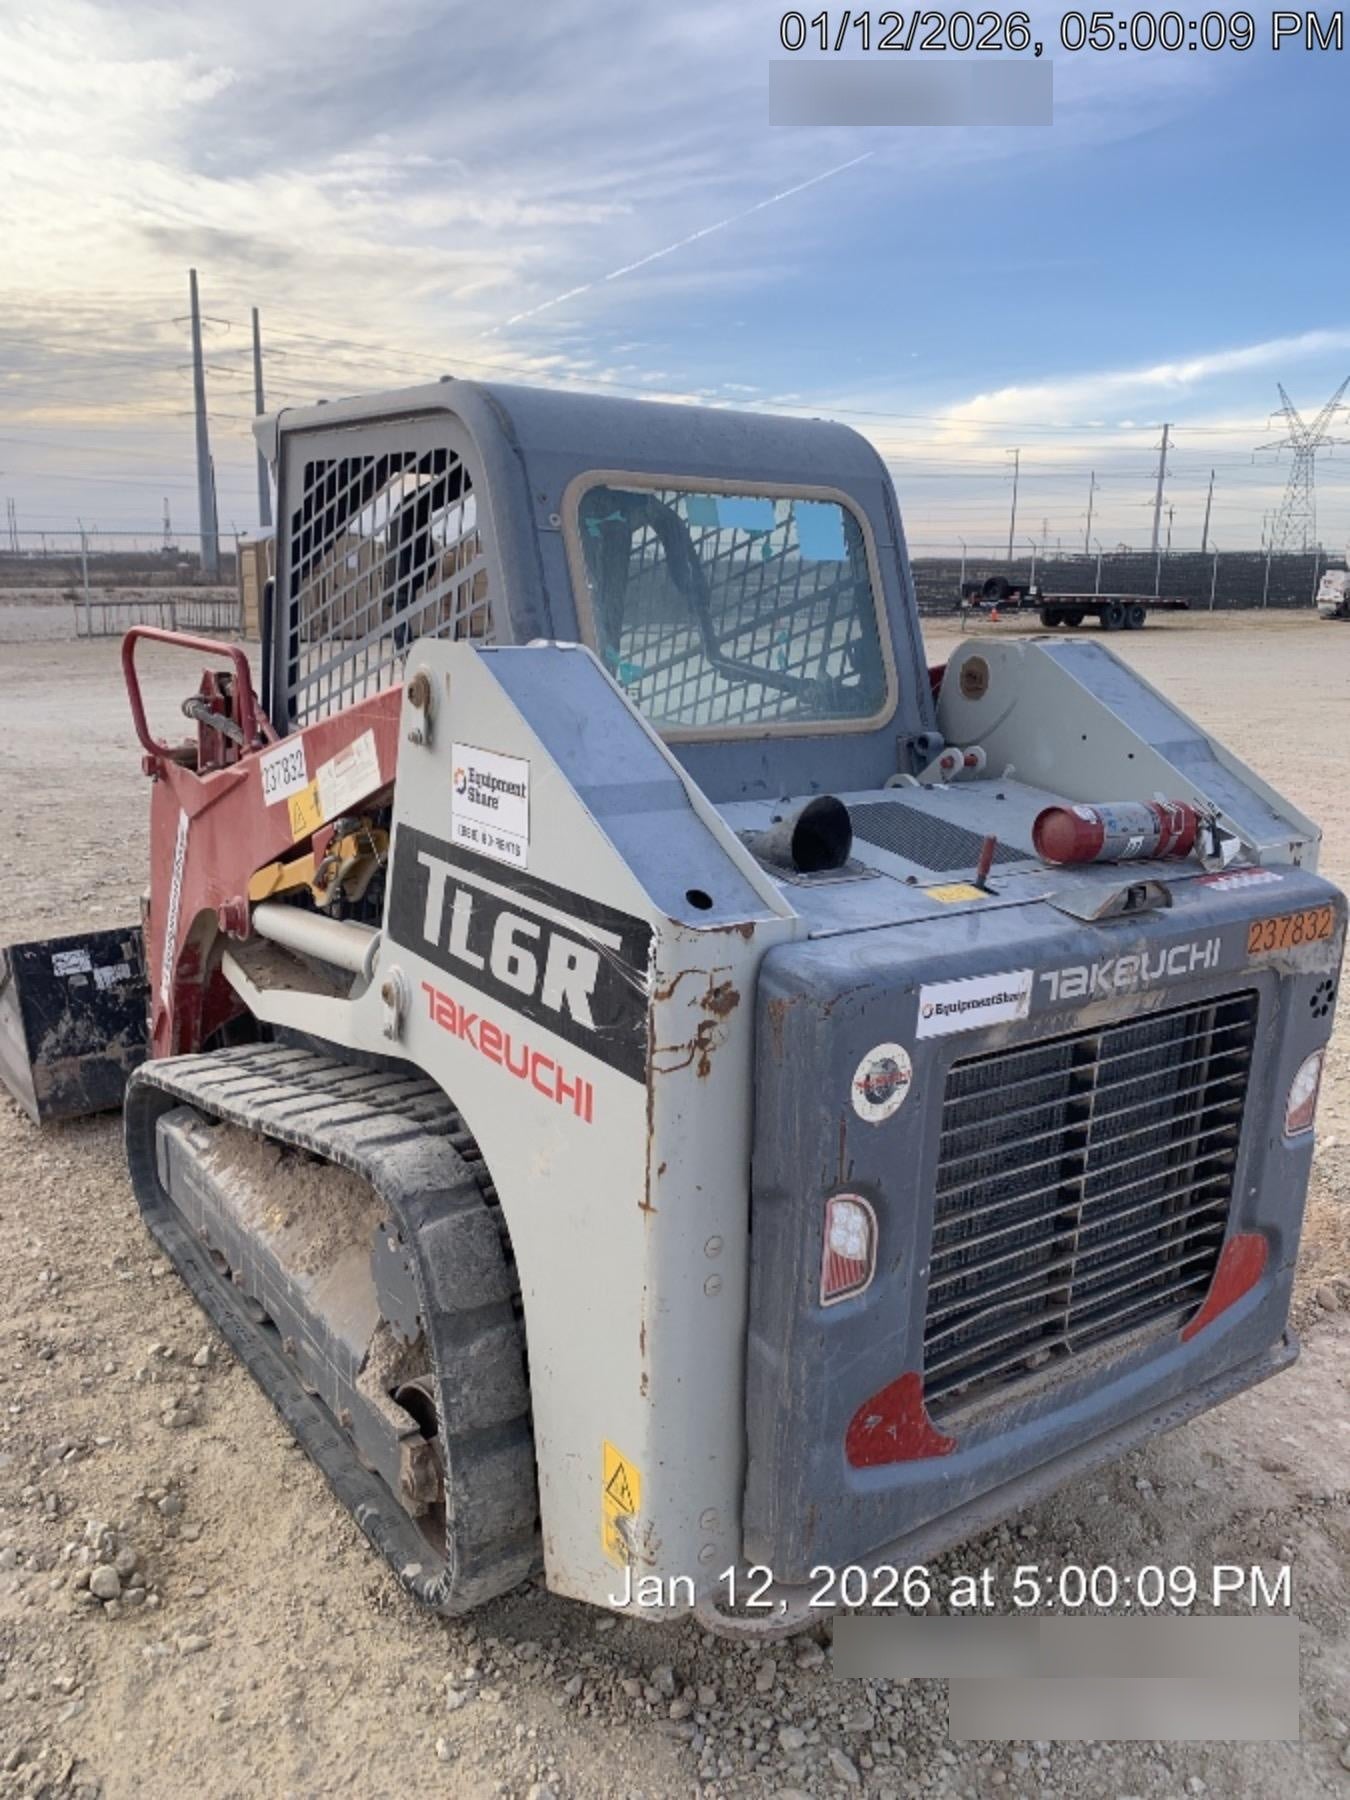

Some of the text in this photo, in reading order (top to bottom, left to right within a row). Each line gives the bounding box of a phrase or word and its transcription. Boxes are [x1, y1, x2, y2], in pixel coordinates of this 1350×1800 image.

[263, 749, 305, 795] 237832
[467, 767, 527, 799] Equipment
[417, 850, 623, 1032] TL6R
[1247, 906, 1331, 955] 237832
[1039, 938, 1221, 1001] TAKEUCHI
[421, 981, 593, 1124] TAKEUCHI
